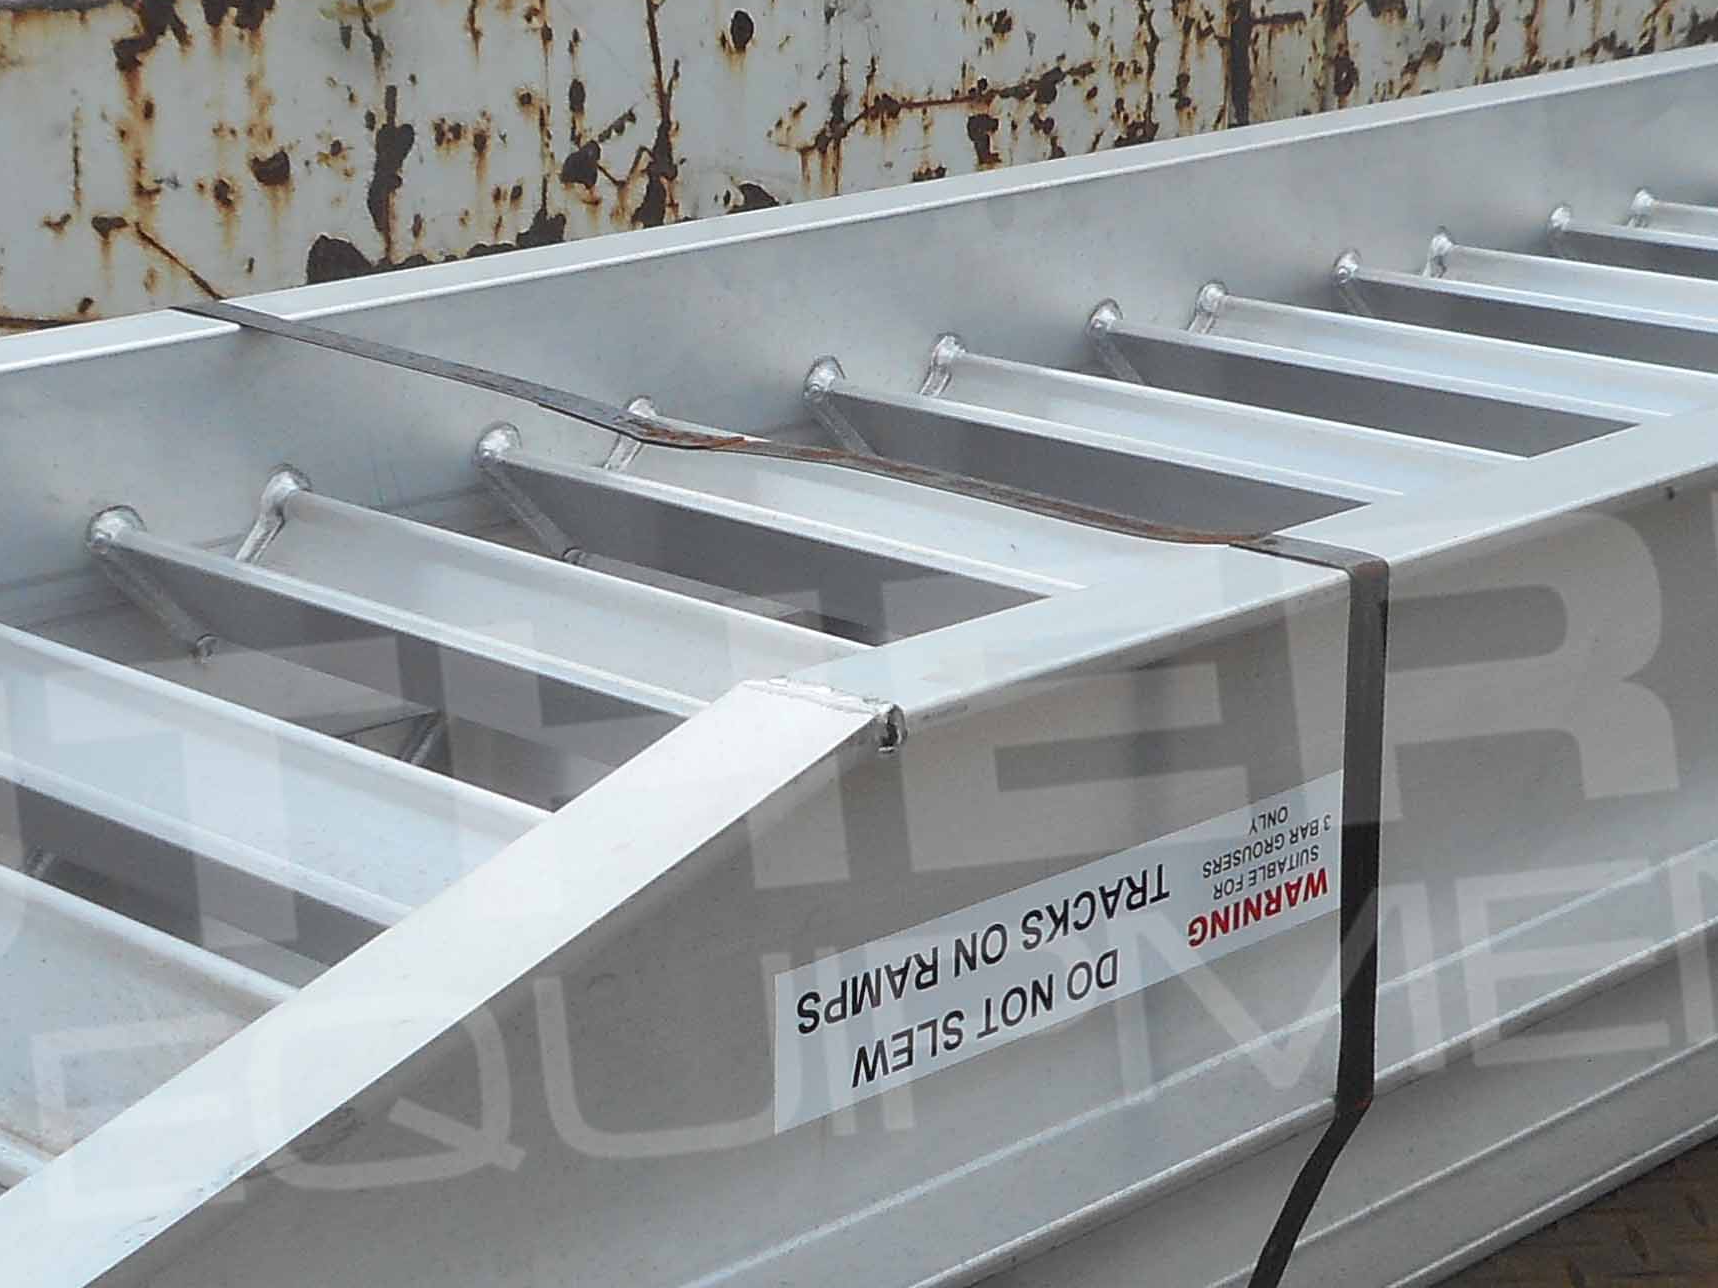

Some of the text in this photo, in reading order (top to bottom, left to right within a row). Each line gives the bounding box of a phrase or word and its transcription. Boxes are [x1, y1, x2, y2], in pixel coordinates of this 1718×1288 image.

[1202, 813, 1332, 879] 3 BAR GROUSERS
[1248, 805, 1289, 836] ONLY
[1187, 867, 1329, 948] WARNING
[1212, 844, 1320, 900] SUITABLE FOR
[796, 862, 1171, 1036] TRACKS ON RAMPS
[851, 948, 1120, 1089] DO NOT SLEW
